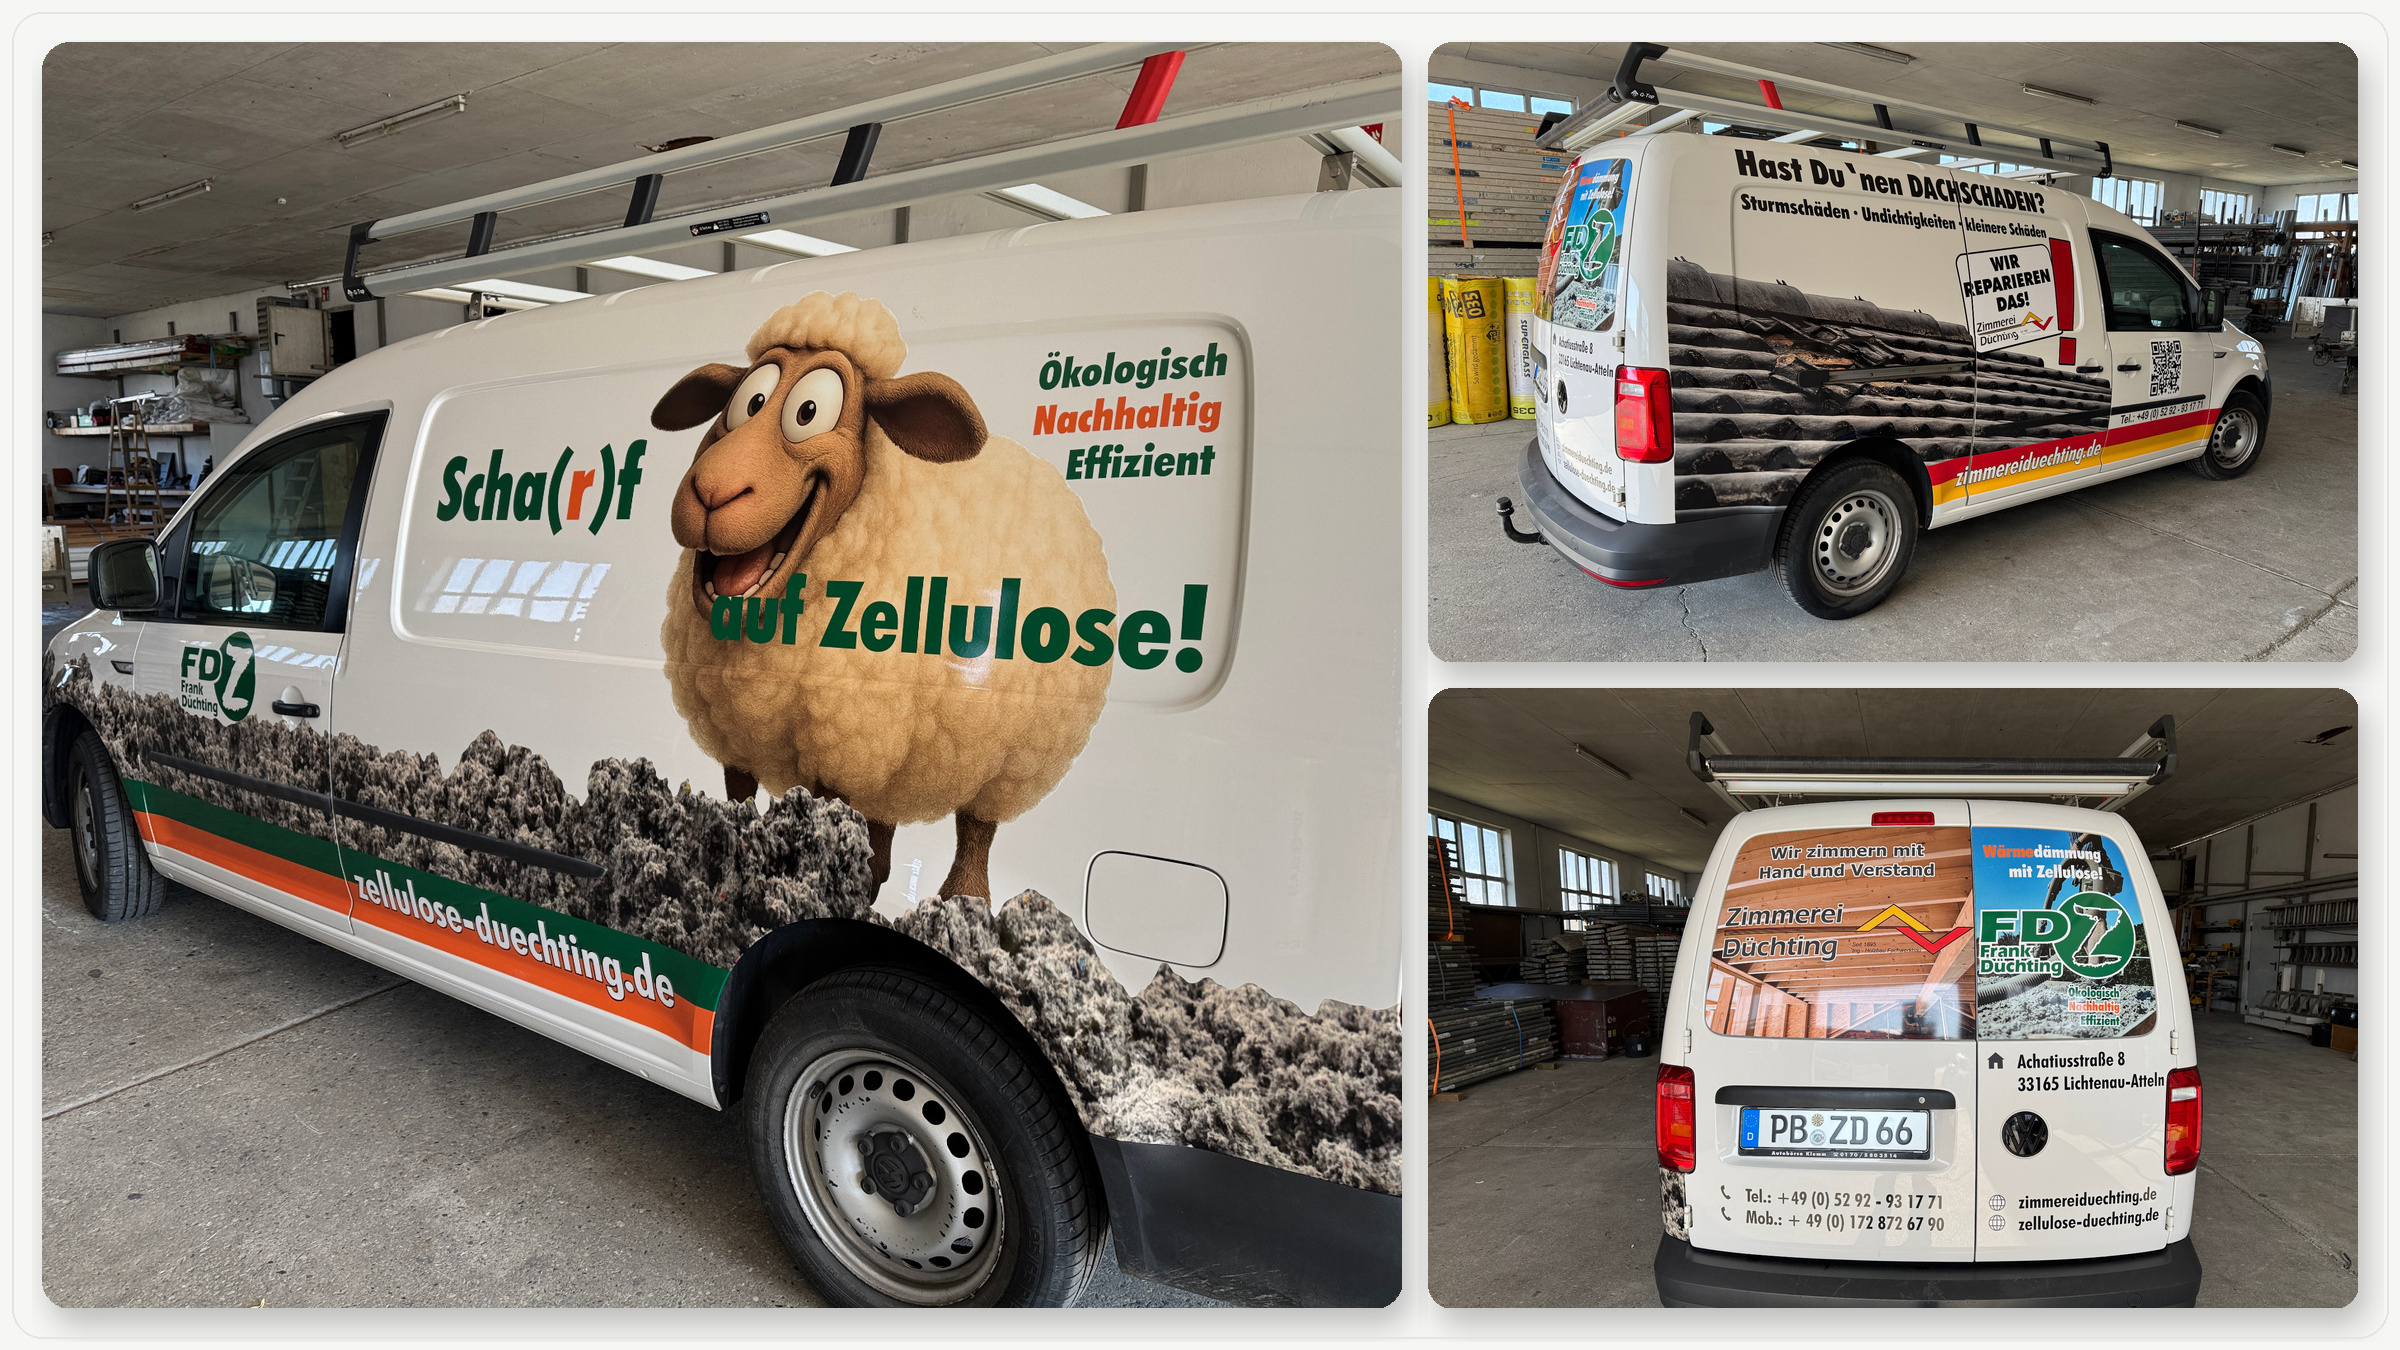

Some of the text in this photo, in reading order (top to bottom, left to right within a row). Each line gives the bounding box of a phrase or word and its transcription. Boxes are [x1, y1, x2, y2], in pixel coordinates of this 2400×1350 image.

[1735, 149, 1802, 182] Hast
[1907, 174, 2045, 214] DACHSCHADEN?
[1740, 193, 2047, 238] Sturmschäden Undichtigkeiten kleinere Schäden
[1990, 254, 2020, 271] WIR
[1963, 268, 2051, 297] REPARIEREN
[1468, 292, 1483, 317] 035
[1996, 291, 2030, 312] DAS!
[1976, 315, 2016, 332] Zimmerei
[1980, 331, 2019, 346] Düchting
[1039, 342, 1228, 390] Ökologisch
[1472, 376, 1479, 384] So
[1033, 391, 1222, 435] Nachhaltig
[2120, 414, 2135, 424] Tel.:
[2137, 411, 2149, 420] +49
[2150, 409, 2159, 421] (0)
[2160, 407, 2167, 417] 52
[2169, 405, 2176, 415] 92
[2181, 404, 2188, 413] 93
[2189, 402, 2196, 411] 17
[2197, 400, 2204, 409] 71
[1066, 442, 1216, 480] Effizient
[1955, 439, 2102, 487] zimmereiduechting.de
[437, 439, 647, 536] Scha(r)f
[710, 573, 1208, 673] auf Zellulose!
[181, 680, 203, 695] Frank
[181, 694, 218, 716] Düchting
[1770, 843, 1925, 860] Wir zimmern mit
[1982, 844, 2101, 863] Wärmedämmung
[1759, 862, 1935, 879] Hand und Verstand
[2009, 864, 2103, 880] mit Zellulose!
[1725, 903, 1844, 927] Zimmerei
[354, 869, 676, 1008] zellulose-duechting.de
[1722, 936, 1838, 961] Düchting
[1980, 944, 2032, 958] Frank
[1980, 958, 2062, 977] Düchting
[2068, 985, 2120, 998] Ökologisch
[2068, 1001, 2120, 1013] Nachhaltig
[2081, 1015, 2120, 1026] Effizient
[2017, 1051, 2125, 1069] Achatiusstraße 8
[2018, 1072, 2165, 1091] 33165 Lichtenau-Atteln
[1770, 1114, 1912, 1145] PB ZD 66
[1745, 1188, 1771, 1203] Tel.:
[1778, 1191, 1807, 1205] +49
[1812, 1191, 1829, 1209] (0)
[1834, 1192, 1850, 1207] 52
[1855, 1193, 1871, 1207] 92
[1886, 1194, 1902, 1208] 93
[1908, 1194, 1923, 1209] 17
[1928, 1195, 1943, 1209] 71
[2018, 1186, 2157, 1209] zimmereiduechting.de
[1746, 1210, 1782, 1226] Mob.:
[1806, 1213, 1822, 1228] 49
[1826, 1214, 1844, 1232] (0)
[1850, 1214, 1873, 1230] 172
[1878, 1215, 1902, 1231] 872
[1907, 1216, 1923, 1231] 67
[1928, 1217, 1944, 1231] 90
[2018, 1207, 2159, 1231] zellulose-duechting.de
